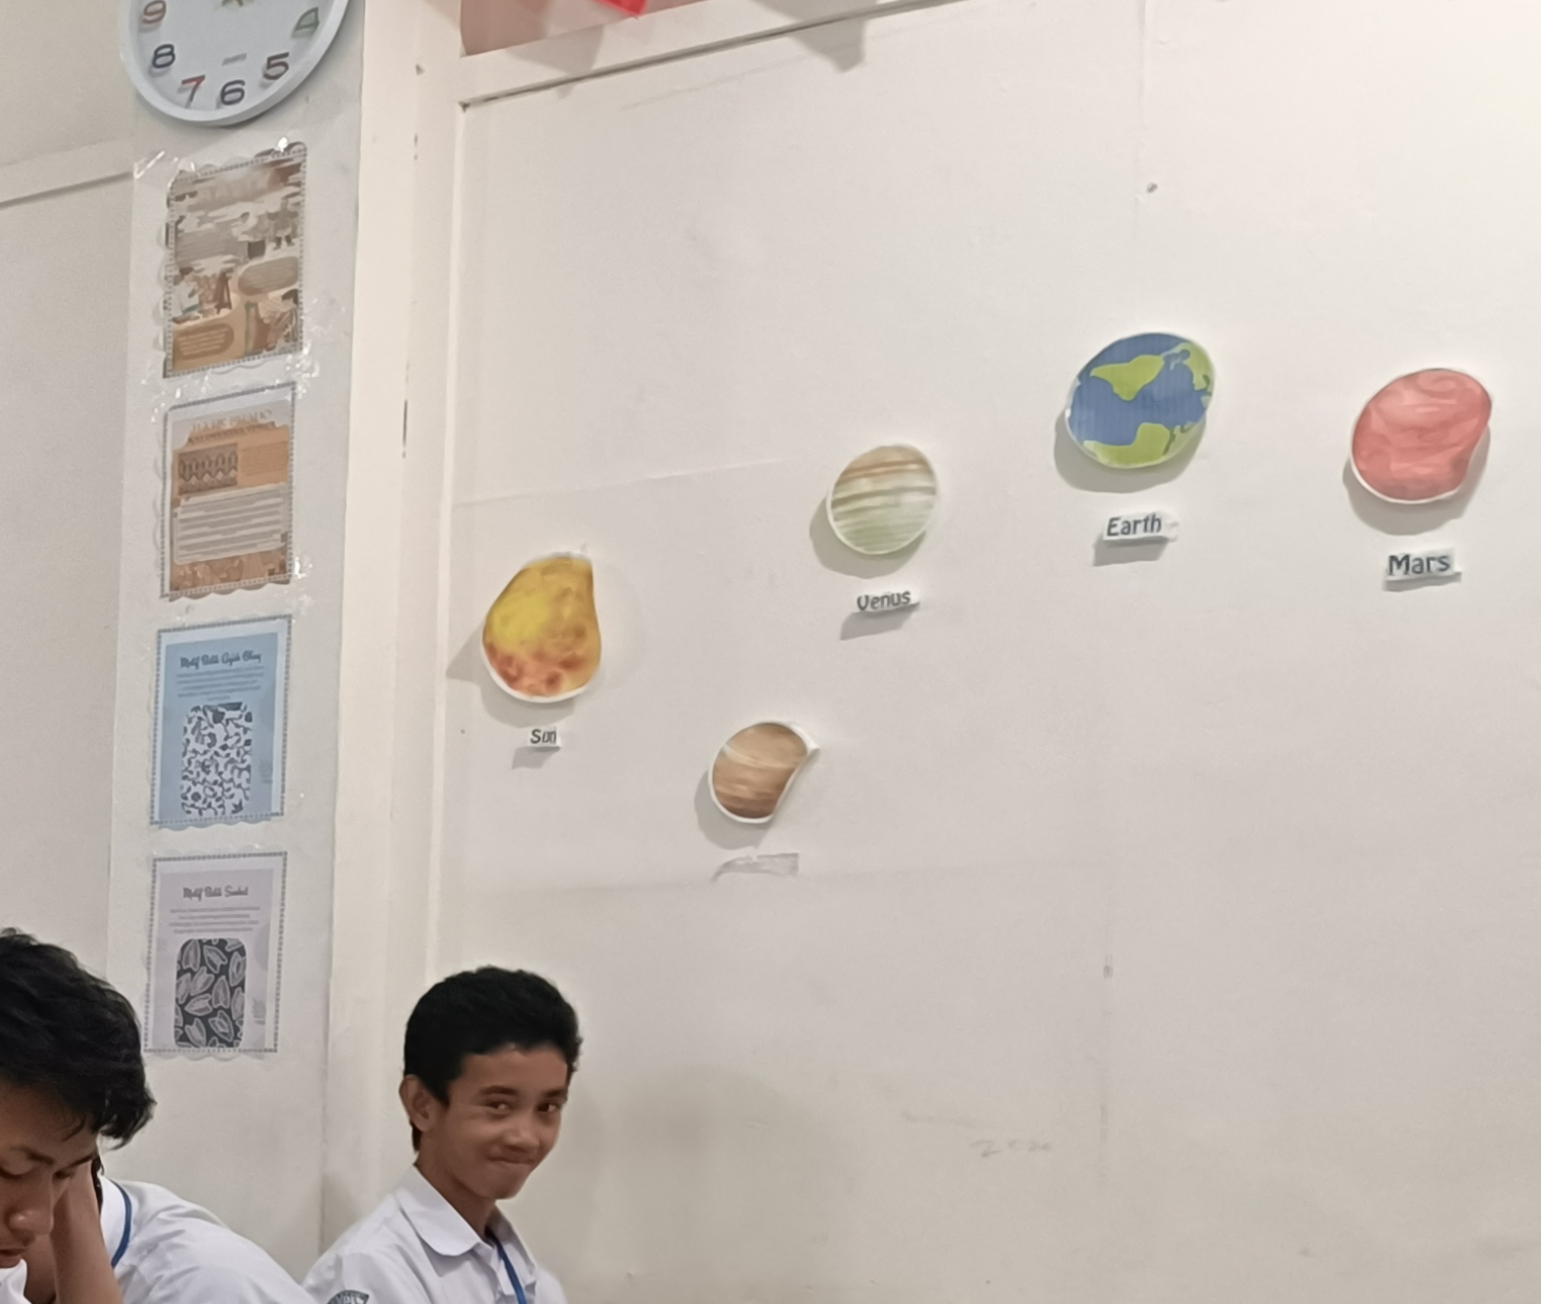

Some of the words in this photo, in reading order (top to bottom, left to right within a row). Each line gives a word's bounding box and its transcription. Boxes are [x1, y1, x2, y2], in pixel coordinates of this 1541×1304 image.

[142, 0, 167, 25] 9
[294, 6, 320, 32] 4
[151, 43, 176, 69] 8
[262, 52, 290, 81] 5
[180, 75, 206, 108] 7
[220, 79, 246, 106] 6
[1106, 511, 1163, 537] Earth
[1387, 553, 1451, 577] Mars
[530, 728, 558, 745] Sun
